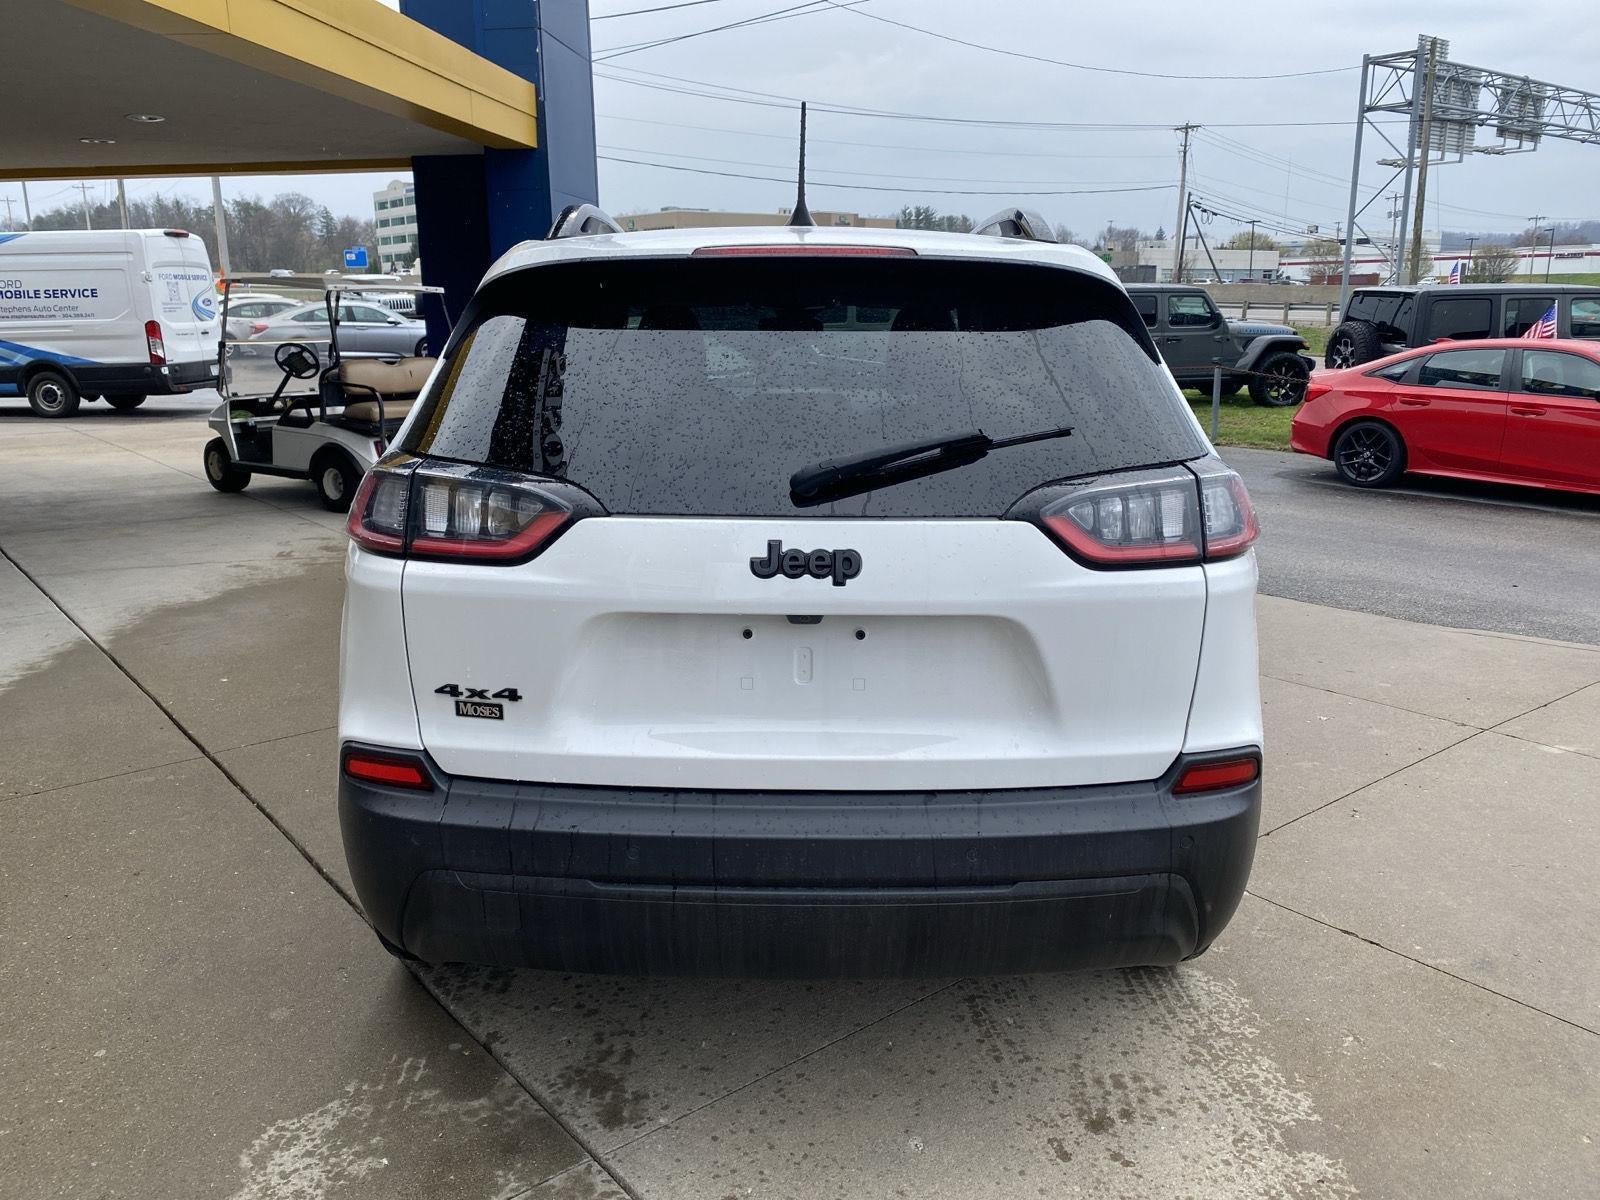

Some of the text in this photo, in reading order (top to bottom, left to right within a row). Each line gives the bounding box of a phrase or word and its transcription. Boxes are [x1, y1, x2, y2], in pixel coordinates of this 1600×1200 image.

[0, 279, 23, 289] ORD
[43, 288, 99, 299] SERVICE
[0, 304, 79, 313] tephens Auto Center
[750, 540, 862, 587] Jeep
[434, 683, 523, 702] 4x4
[459, 702, 500, 717] MOSES
